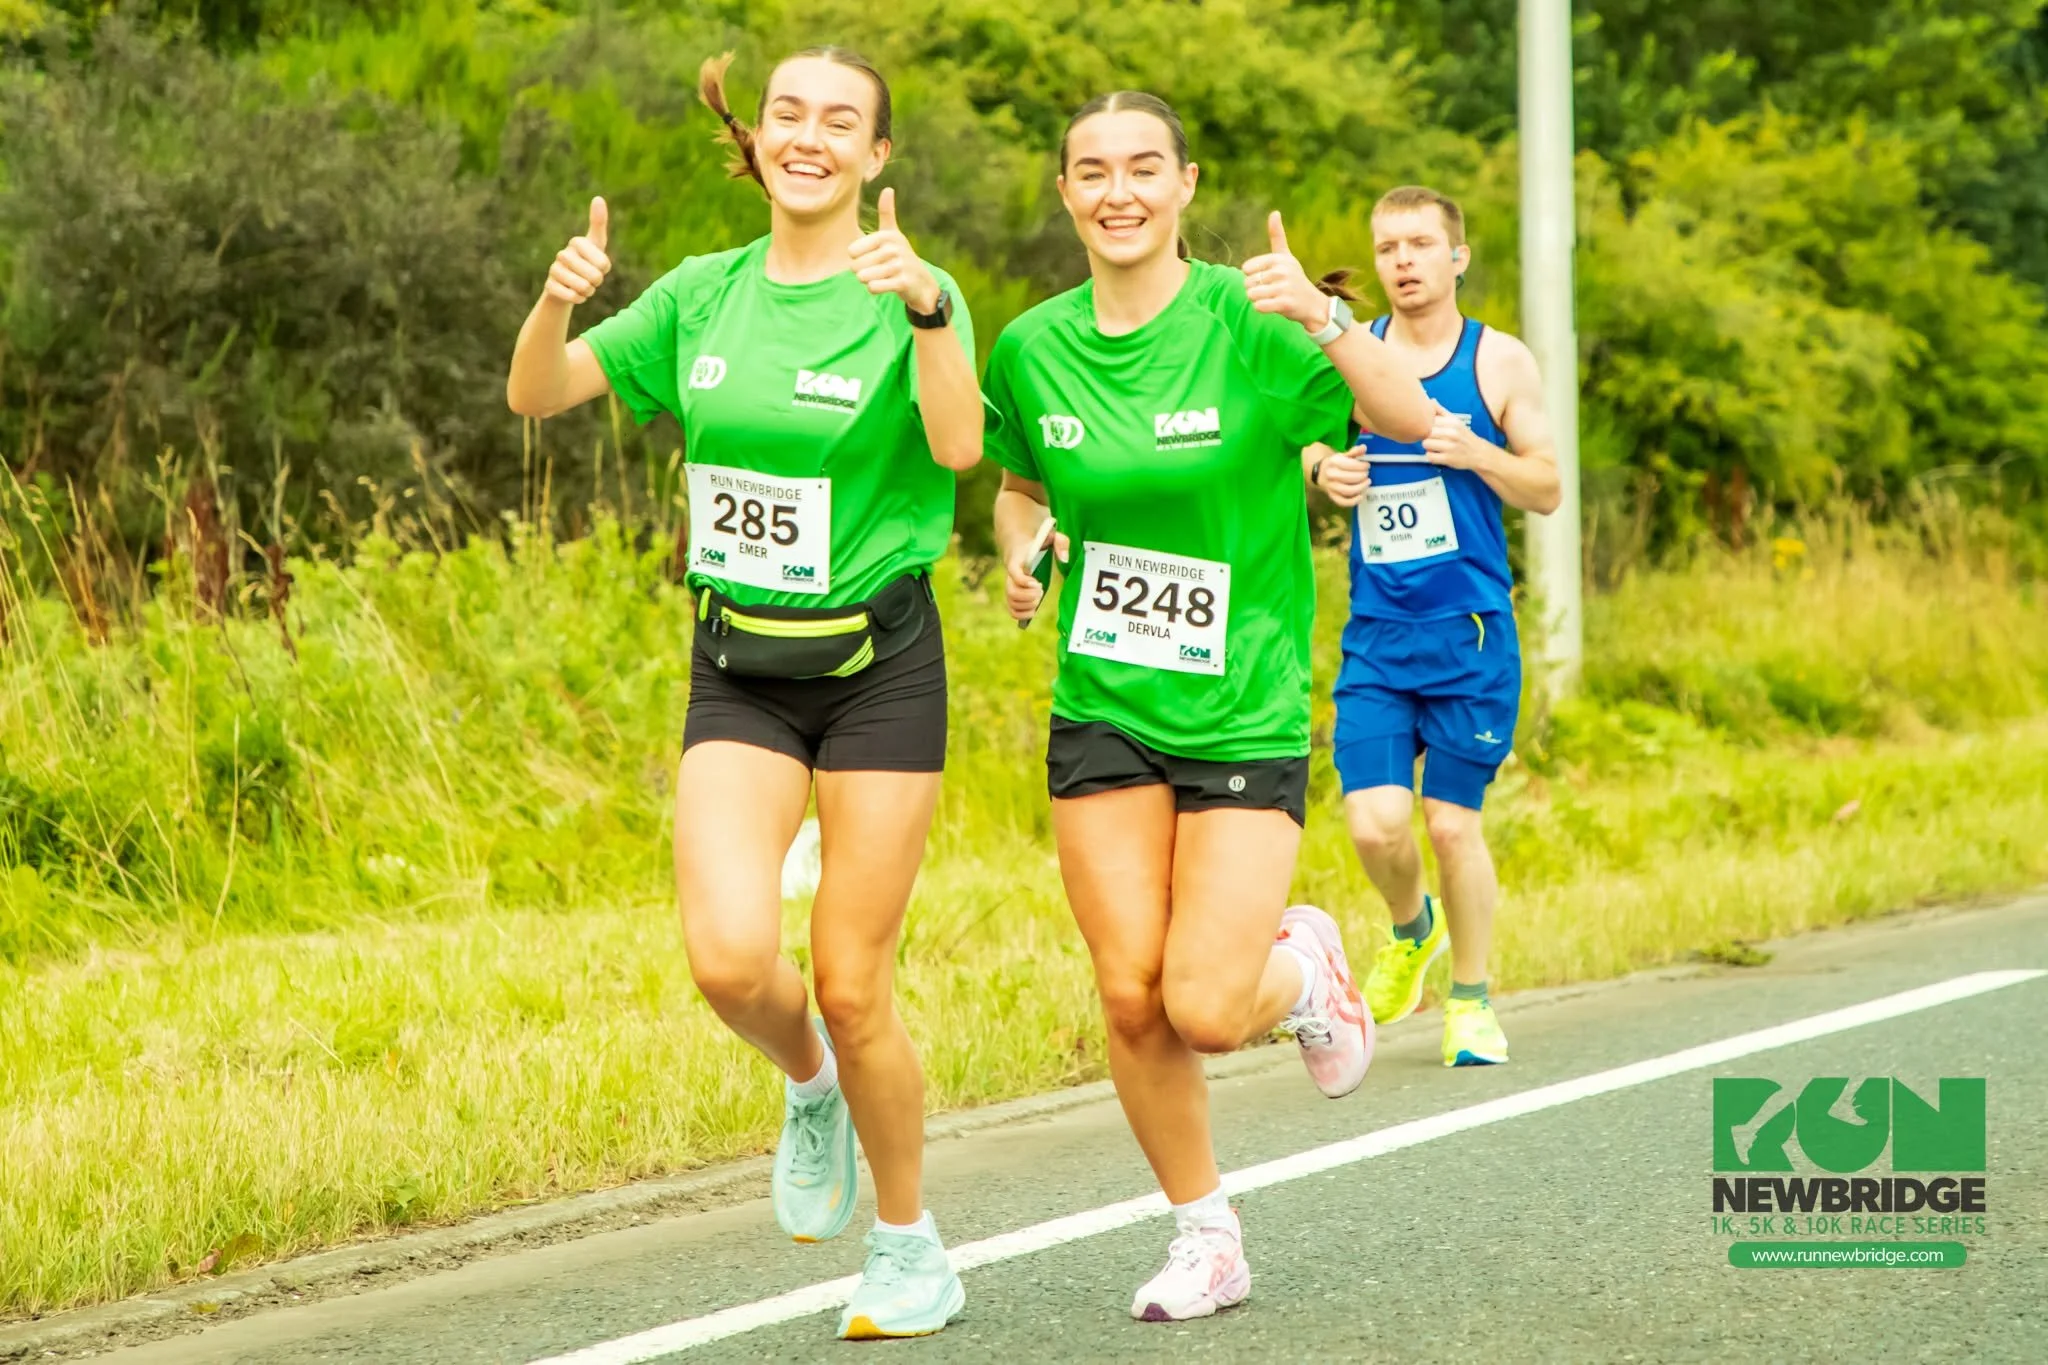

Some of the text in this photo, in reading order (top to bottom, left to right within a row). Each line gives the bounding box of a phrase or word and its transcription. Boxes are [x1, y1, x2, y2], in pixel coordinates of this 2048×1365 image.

[793, 392, 857, 410] NEWBRIDGE
[1156, 431, 1221, 445] NEWBRIDGE
[710, 474, 802, 500] RUN NEWBRIDGE
[713, 492, 799, 546] 285
[1377, 503, 1418, 531] 30
[739, 542, 768, 559] EMER
[1109, 553, 1205, 580] RUN NEWBRIDGE
[1092, 570, 1215, 628] 5248
[1128, 621, 1171, 639] DERVLA
